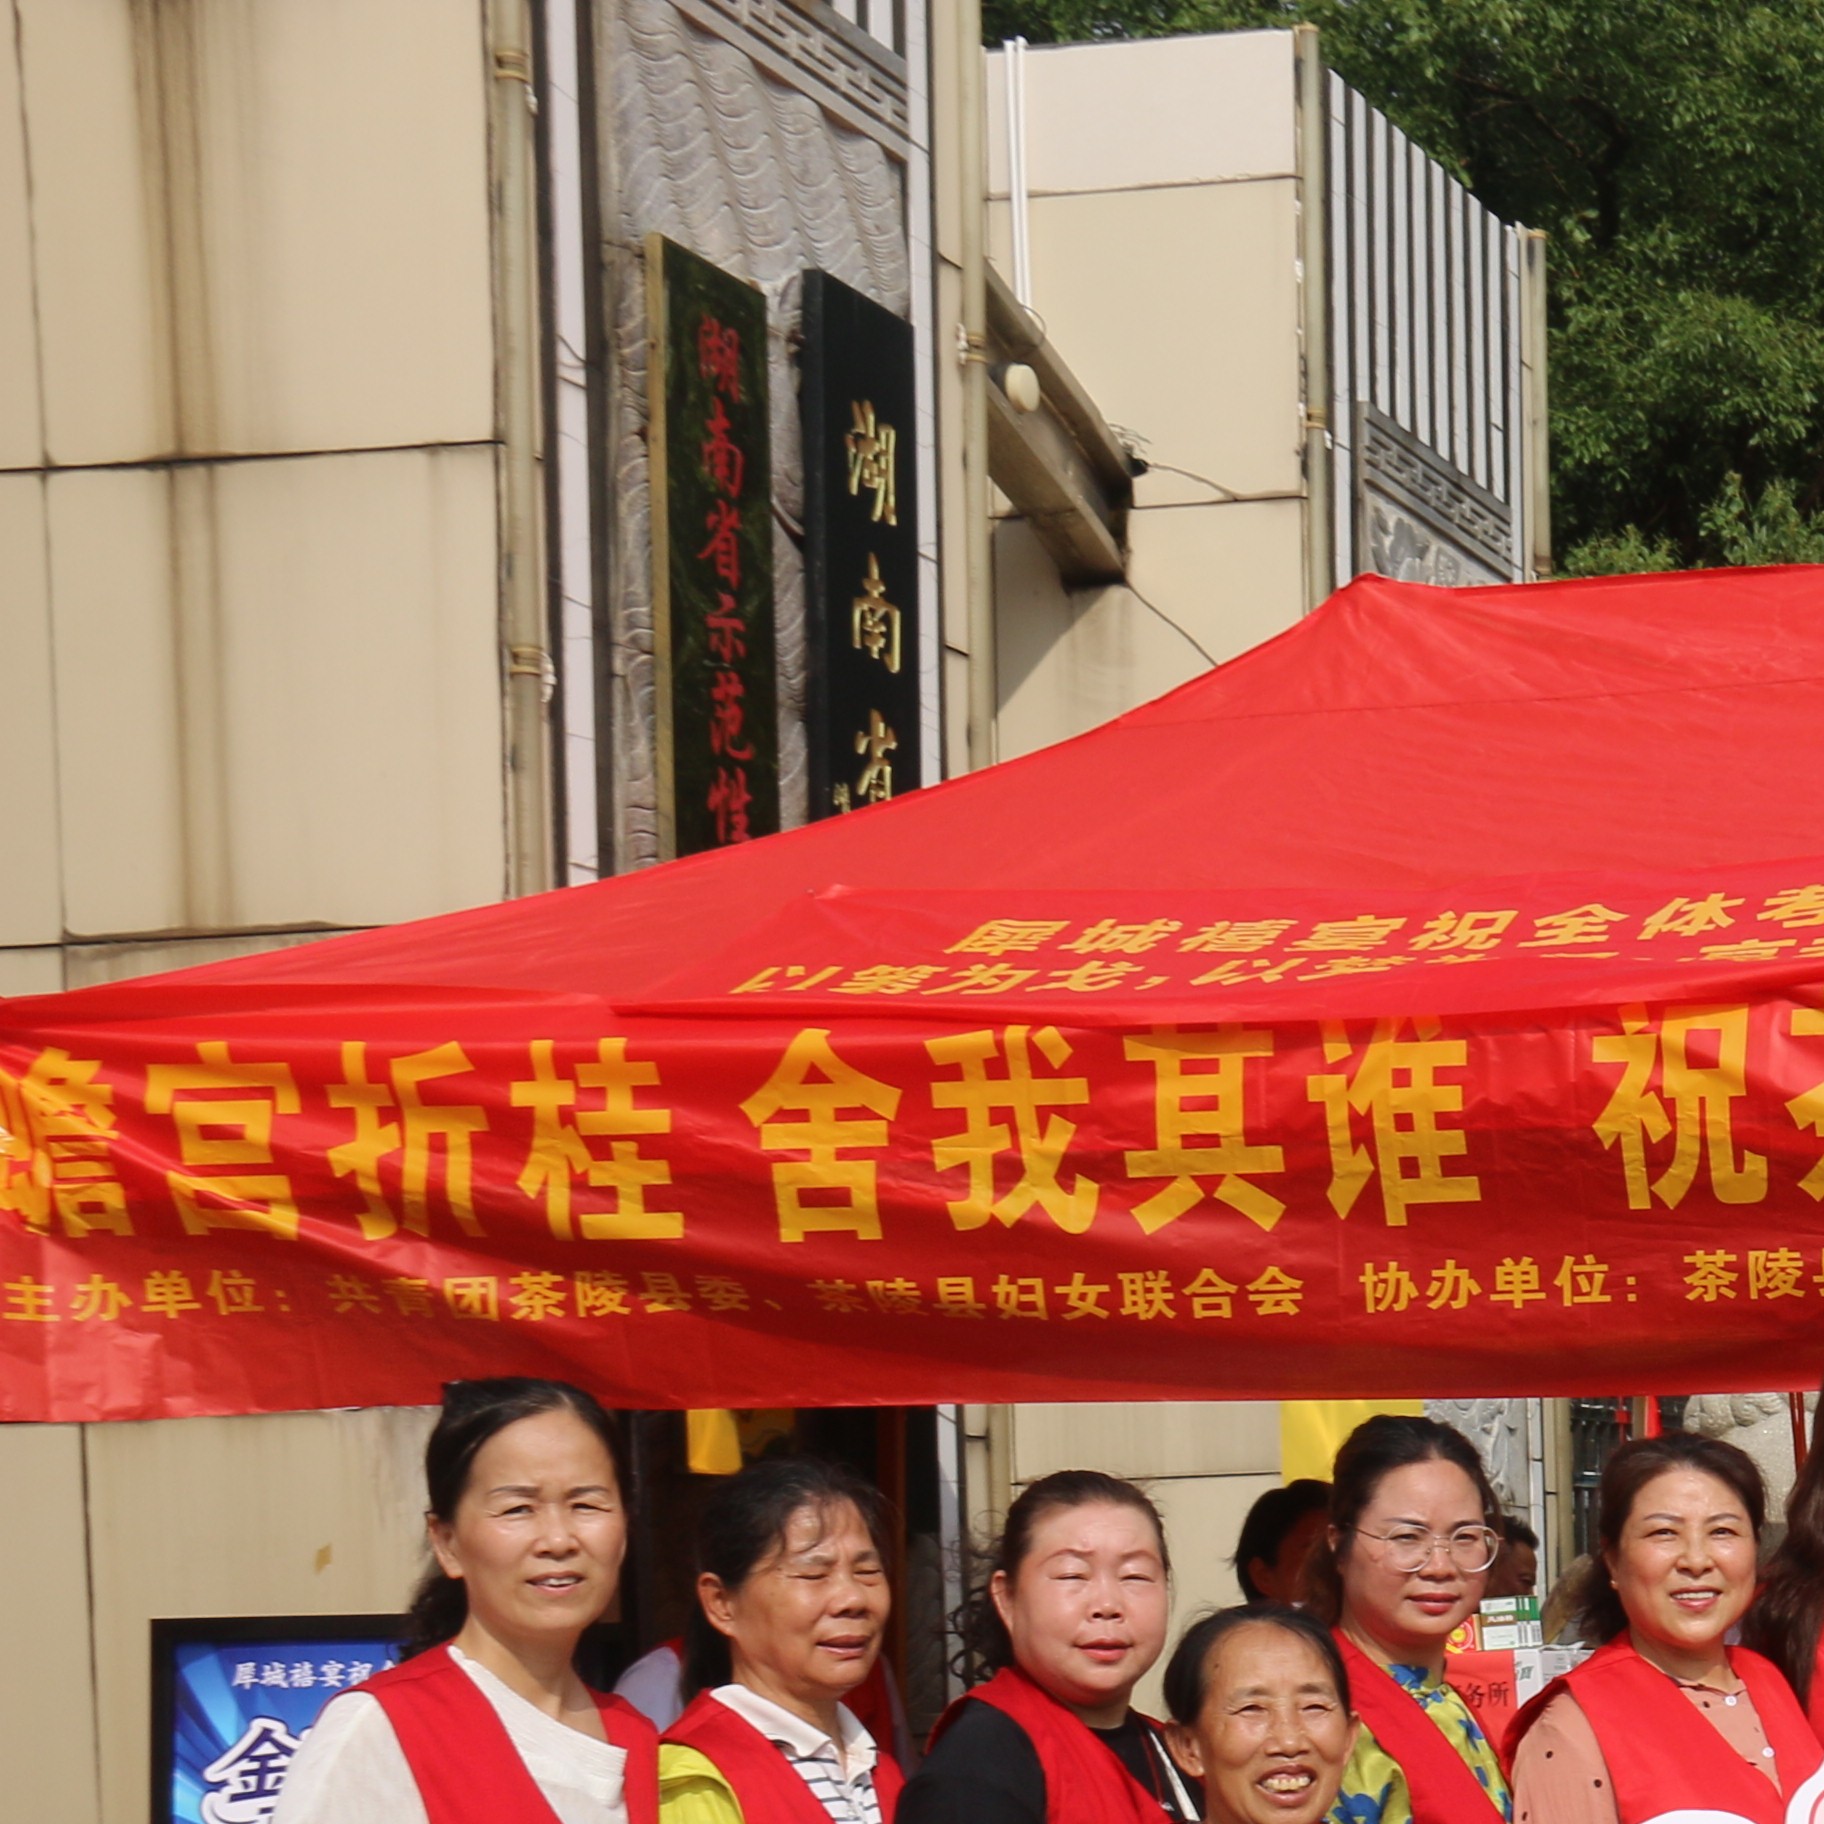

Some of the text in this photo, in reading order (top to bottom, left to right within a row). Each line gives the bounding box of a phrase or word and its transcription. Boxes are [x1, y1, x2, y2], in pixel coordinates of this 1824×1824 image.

[740, 1019, 1482, 1244] 舍我其谁
[231, 1660, 396, 1690] 犀城禧宴祝
